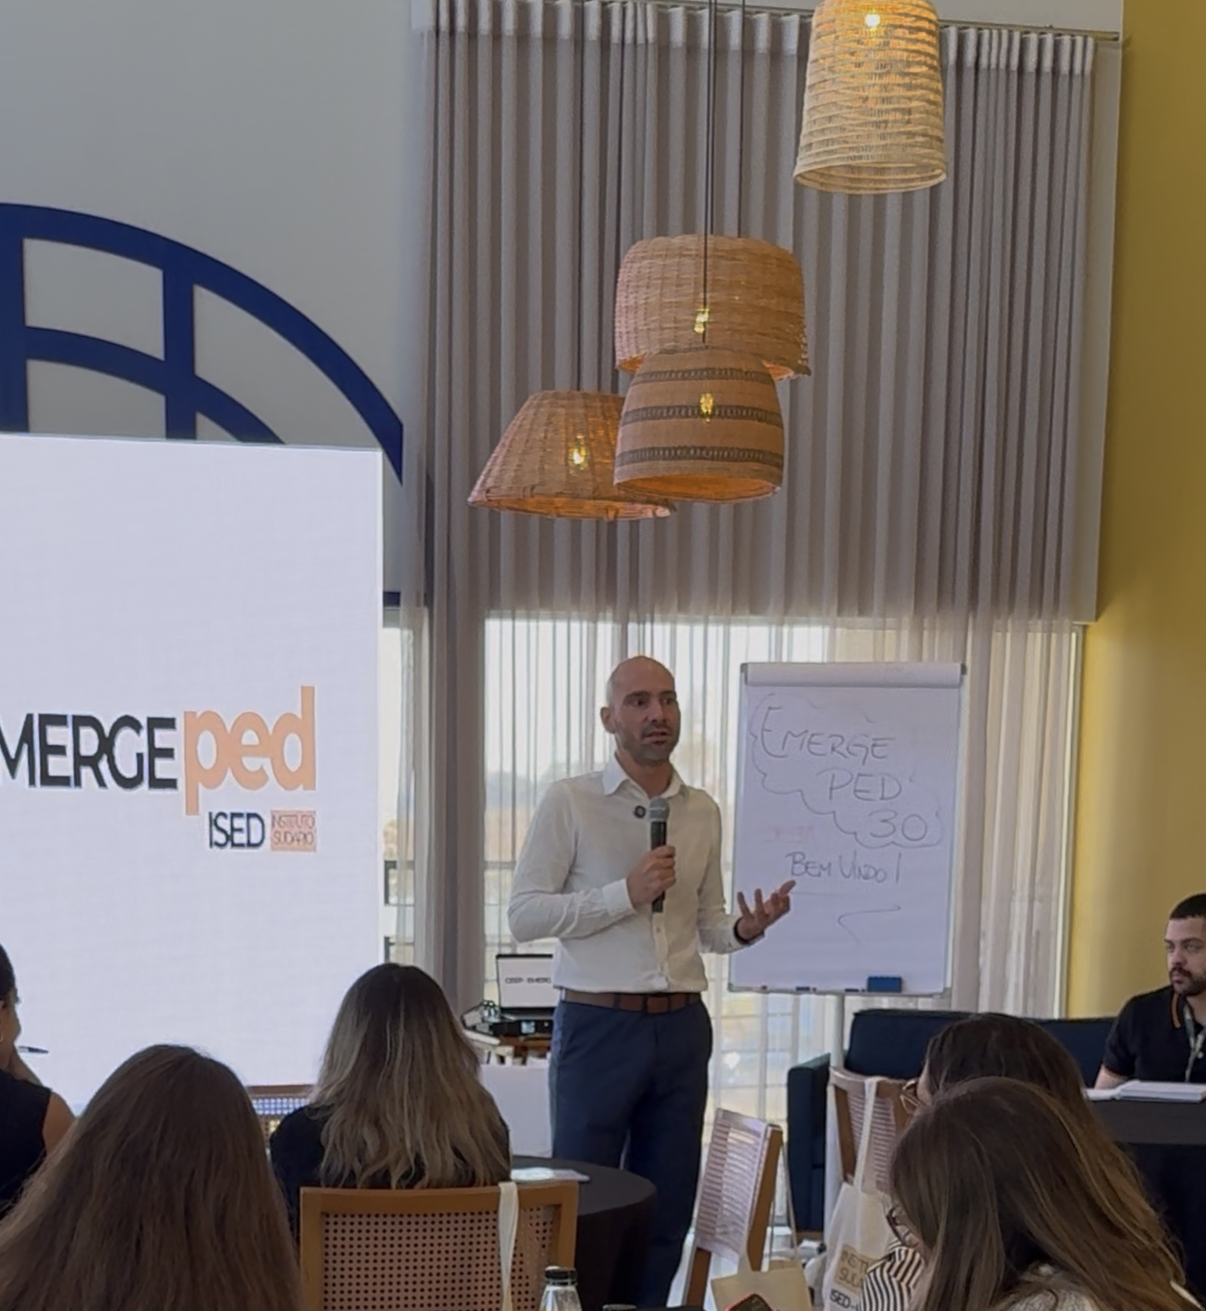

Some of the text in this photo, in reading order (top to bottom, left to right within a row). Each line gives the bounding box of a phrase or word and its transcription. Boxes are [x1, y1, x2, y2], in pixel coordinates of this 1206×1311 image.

[184, 686, 316, 816] ped
[760, 706, 896, 765] EMERGE
[816, 768, 902, 802] PED
[208, 811, 266, 849] ISED
[868, 809, 928, 842] 30
[786, 851, 833, 878] BEM
